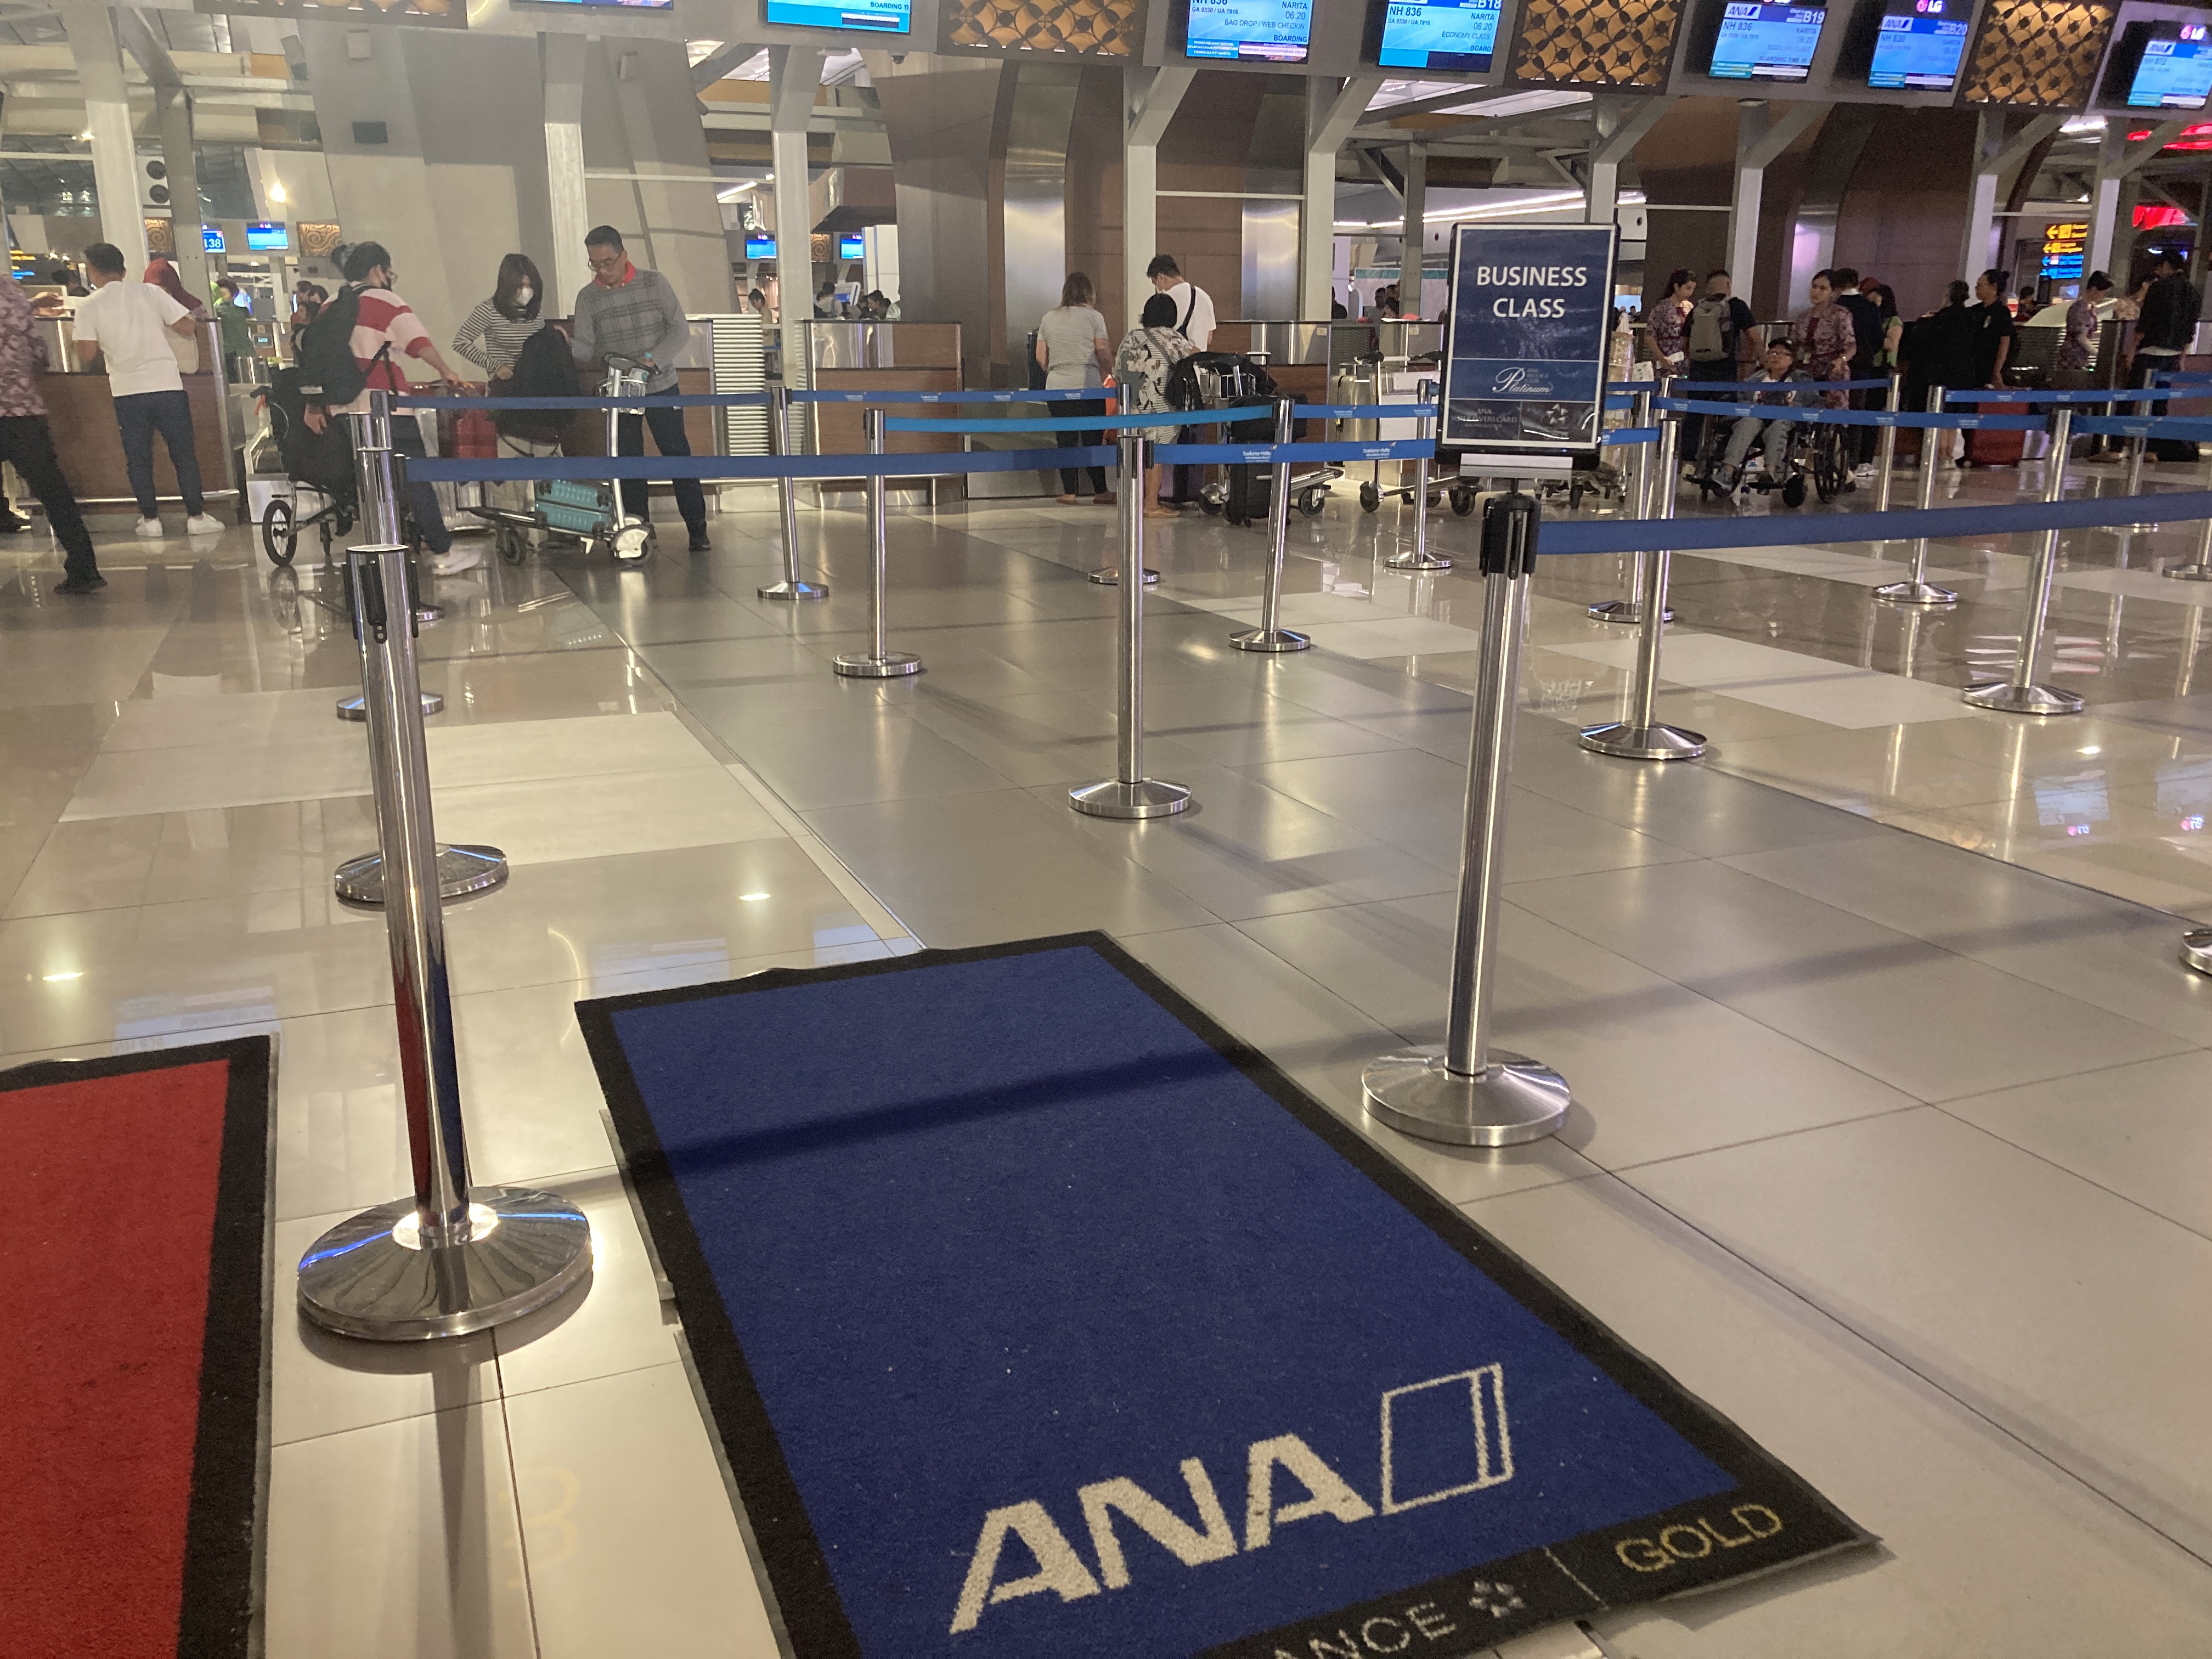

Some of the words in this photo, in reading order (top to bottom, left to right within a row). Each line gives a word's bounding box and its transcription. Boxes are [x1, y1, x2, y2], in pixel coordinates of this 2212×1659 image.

[1389, 6, 1403, 15] NH
[1406, 7, 1421, 16] 836
[1477, 0, 1501, 9] B18
[1728, 7, 1748, 15] ANA
[1285, 12, 1306, 20] 06:20
[1803, 10, 1825, 24] B19
[1723, 21, 1736, 30] NH
[1737, 22, 1753, 31] 836
[1476, 266, 1587, 286] BUSINESS
[1493, 297, 1565, 318] CLASS
[1492, 366, 1554, 393] Platinum
[950, 1433, 1375, 1635] ANA
[1615, 1504, 1782, 1571] GOLD
[1274, 1602, 1457, 1659] NCE
